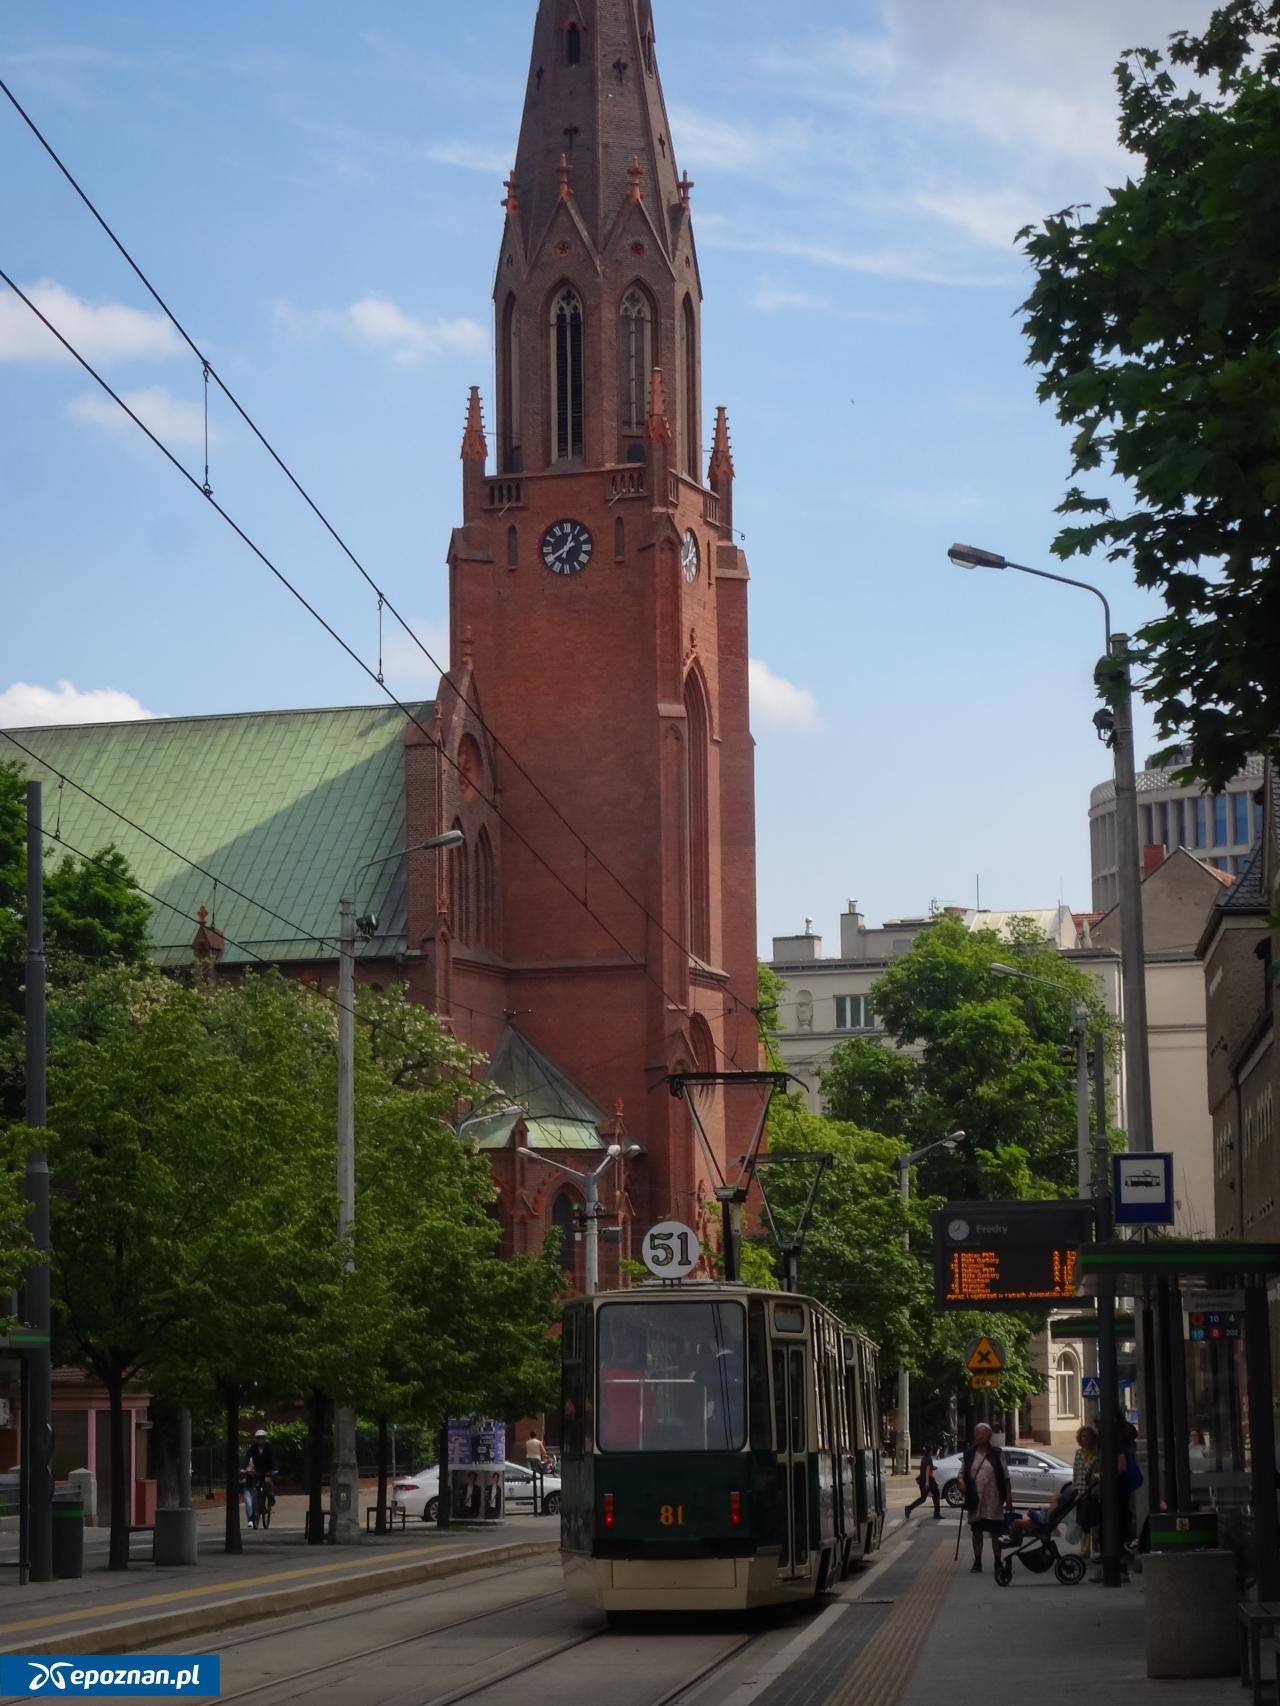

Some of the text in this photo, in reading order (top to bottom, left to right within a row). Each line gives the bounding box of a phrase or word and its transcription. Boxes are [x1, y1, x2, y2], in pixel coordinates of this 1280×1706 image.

[976, 1224, 1008, 1235] Fredry
[649, 1232, 691, 1266] 51
[659, 1504, 684, 1526] 81
